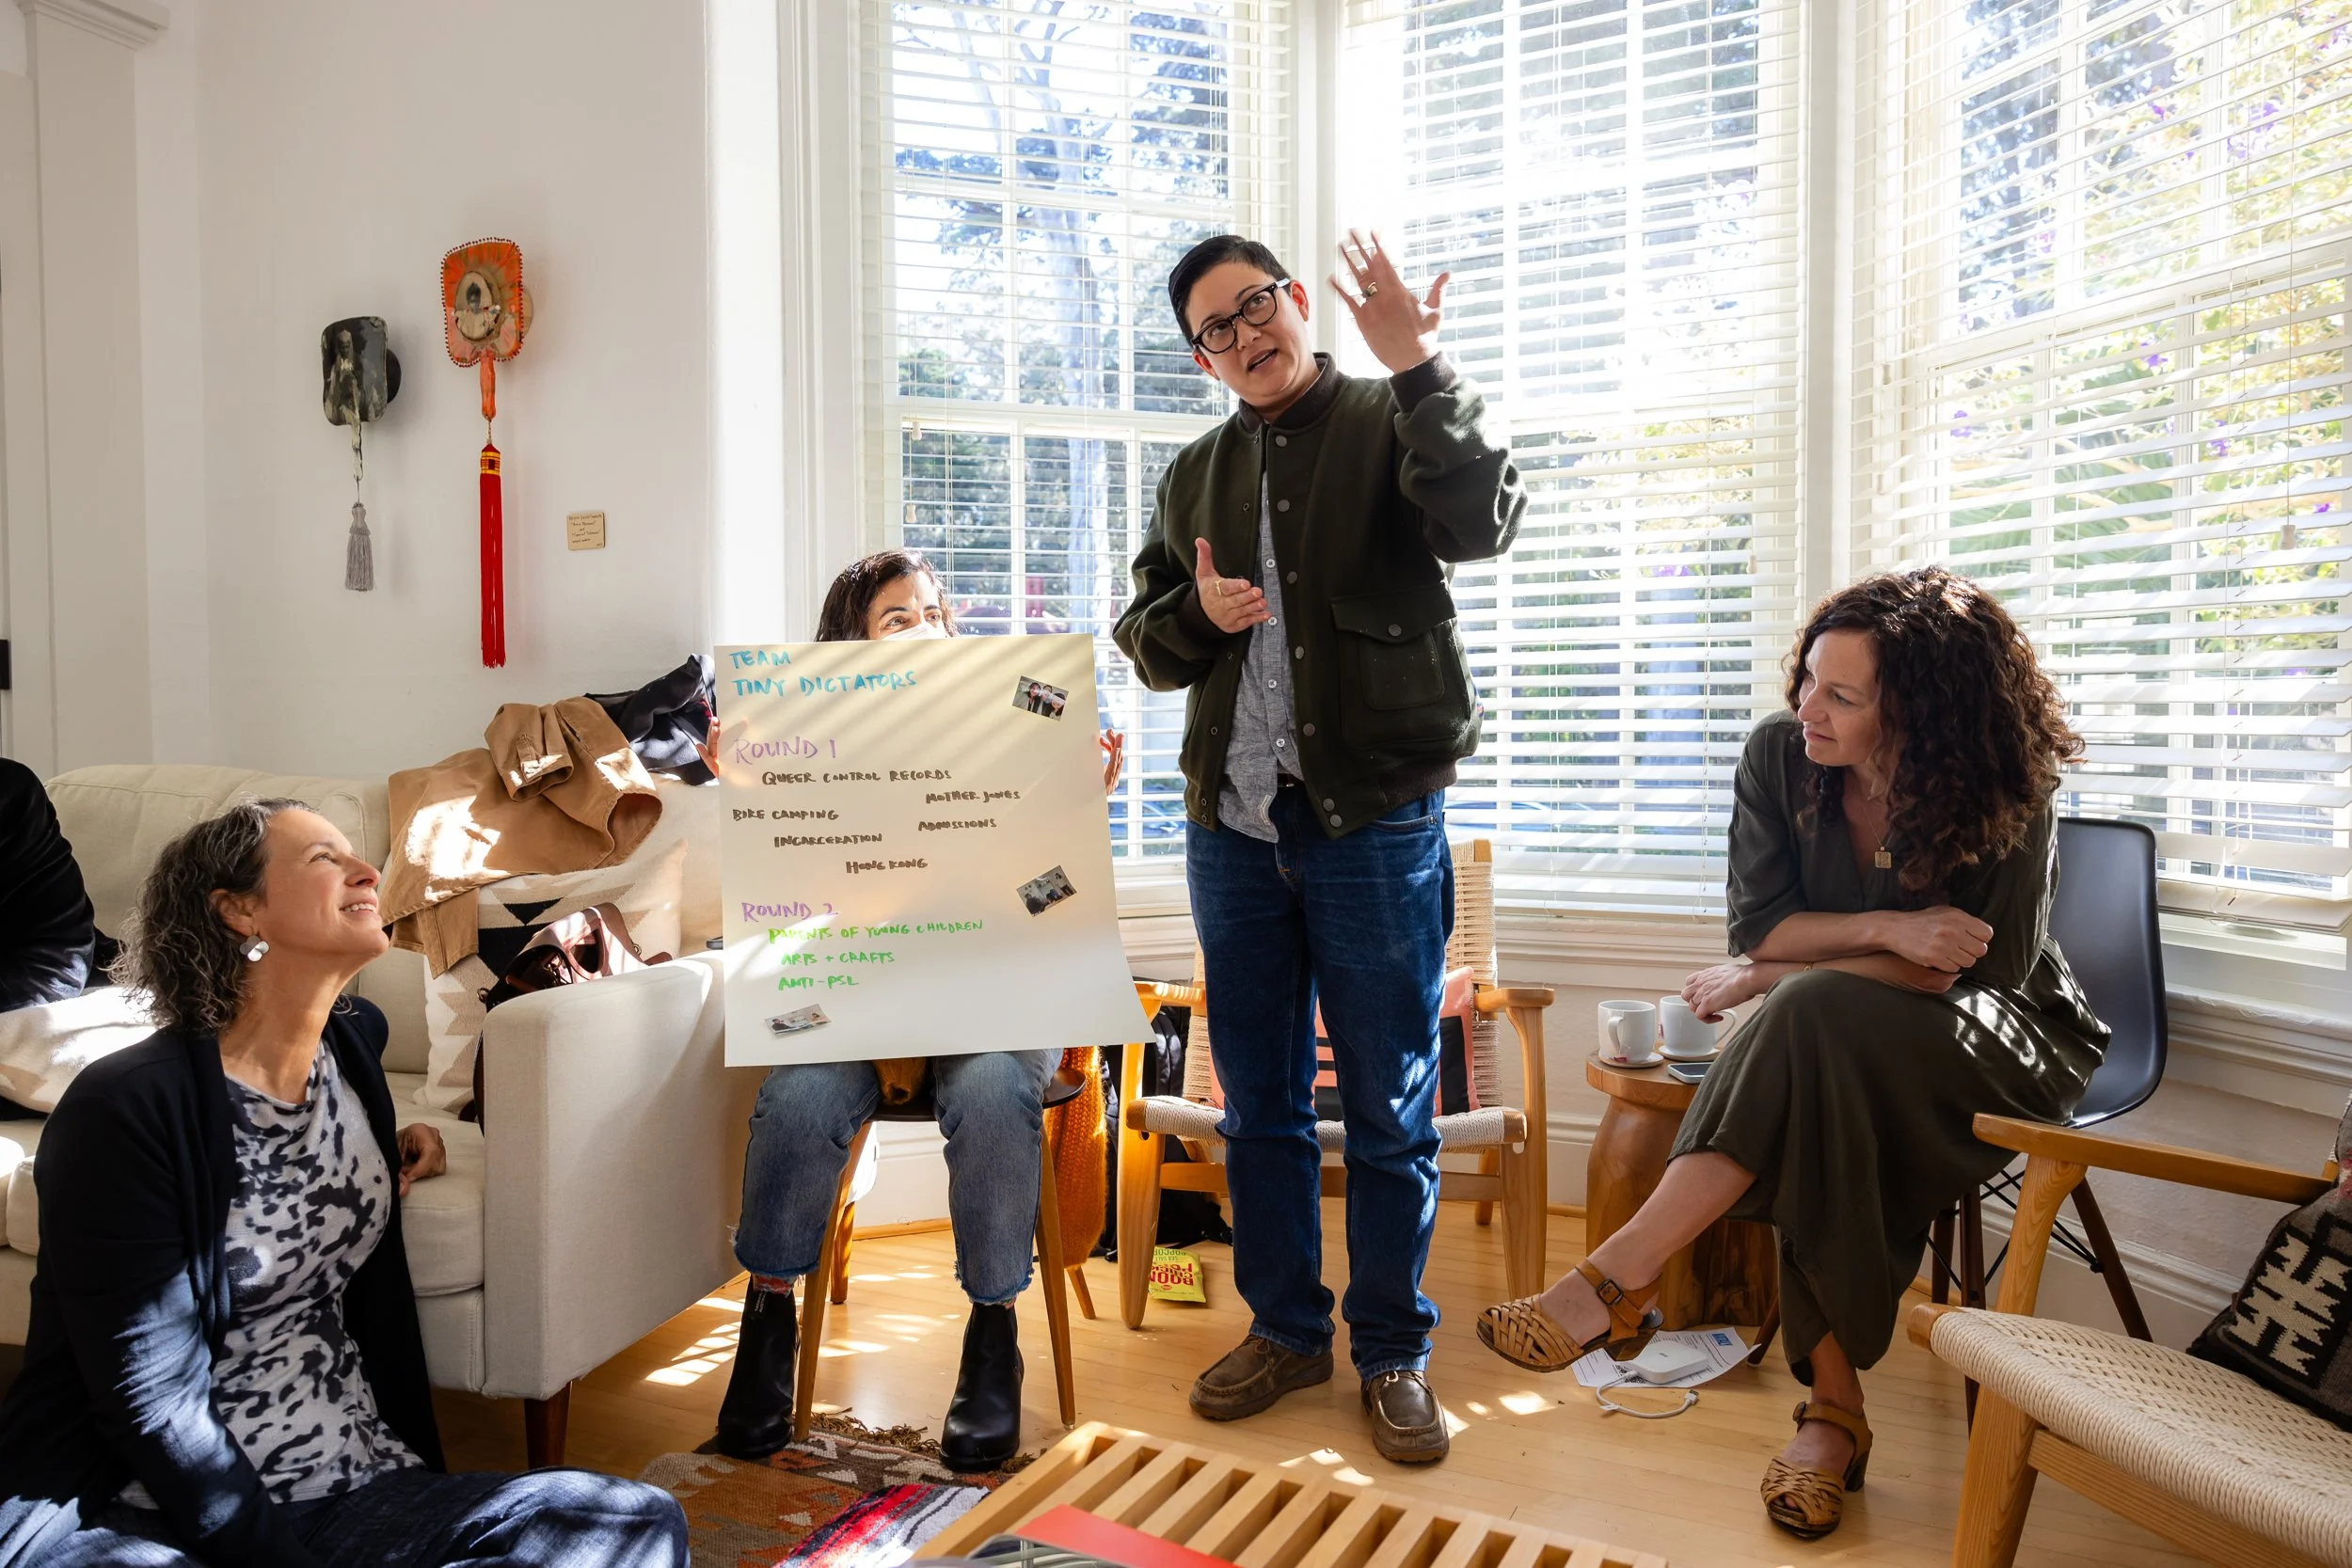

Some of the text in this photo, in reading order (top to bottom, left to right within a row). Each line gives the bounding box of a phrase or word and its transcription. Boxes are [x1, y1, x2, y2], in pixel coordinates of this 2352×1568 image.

[729, 650, 791, 669] TEAM
[731, 671, 917, 697] TINY DICTATORS
[735, 736, 836, 765] ROUND 1
[762, 769, 952, 785] QUEER CONTROL RECORDS
[926, 790, 1021, 804] MOTHER JONES
[732, 809, 839, 821] BIKE CAMPING
[773, 832, 882, 847] INCARCERATION
[846, 858, 929, 874] HONG KONG
[741, 902, 839, 922] ROUND 2
[768, 919, 983, 944] PARENTS OF YOUNG CHILDREN
[781, 952, 818, 966] ARTS
[839, 951, 896, 964] CRAFTS
[778, 974, 859, 991] ANTI-PSL
